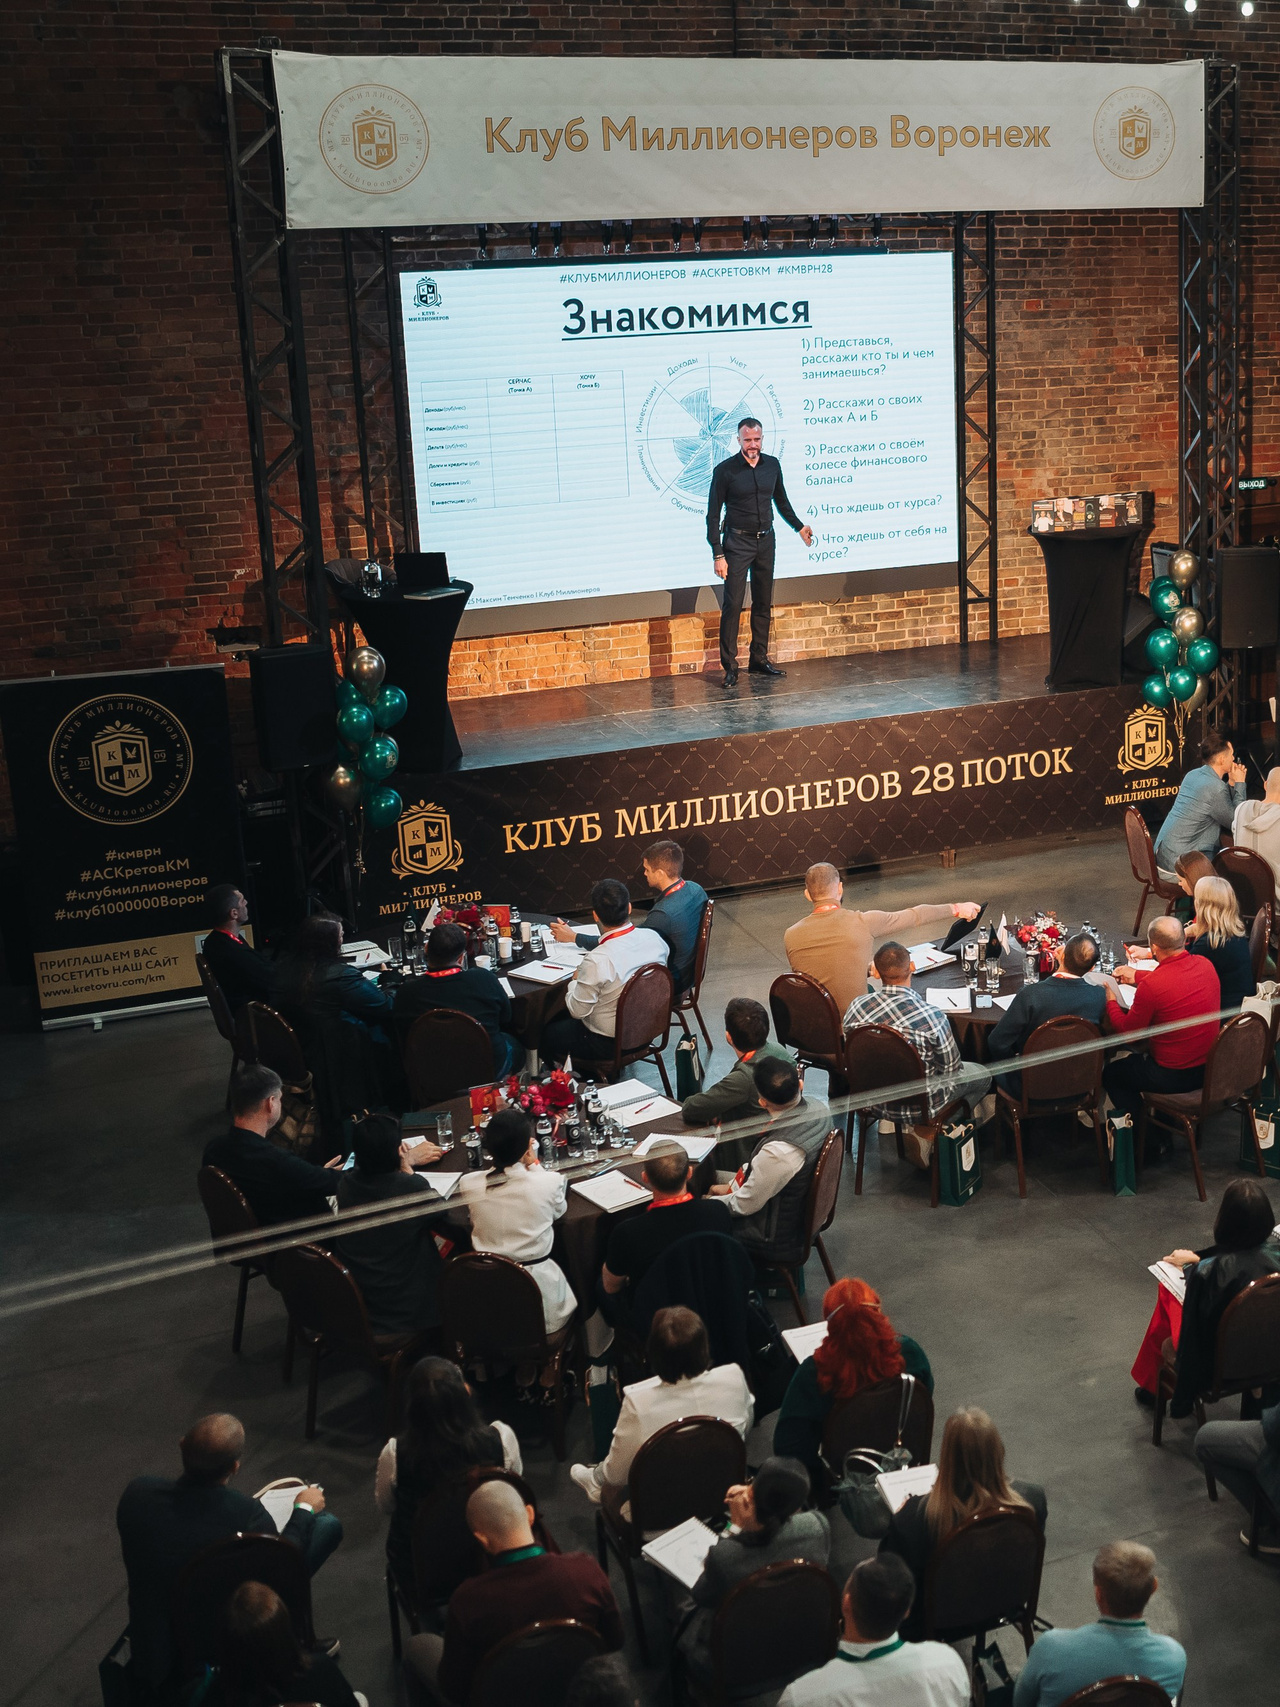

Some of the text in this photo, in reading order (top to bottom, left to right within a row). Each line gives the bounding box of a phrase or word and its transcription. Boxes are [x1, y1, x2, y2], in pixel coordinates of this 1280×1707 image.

[485, 114, 1051, 161] Клуб Миллионеров Воронеж
[559, 264, 833, 284] #КЛУБМИЛЛИОНЕРОВ #АСКРЕТОВКМ #КМВРН28
[562, 298, 810, 335] Знакомимся
[801, 336, 894, 351] 1) Представься,
[667, 356, 699, 377] Доходы
[729, 355, 748, 370] Учет
[801, 349, 934, 367] расскажи кто ты и чем
[508, 377, 531, 385] СЕЙЧАС
[802, 364, 887, 380] занимаешься?
[636, 385, 658, 433] Инвестиции
[766, 384, 784, 419] Расходы
[803, 395, 923, 413] 2) Расскажи о своих
[803, 416, 843, 425] точках
[847, 412, 856, 422] А
[871, 410, 878, 421] Б
[804, 438, 925, 458] 3) Расскажи о своём
[637, 445, 661, 492] Планирование
[805, 454, 928, 471] колесе финансового
[805, 475, 853, 486] баланса
[1239, 480, 1265, 488] ВЫХОД
[670, 497, 705, 515] Обучение
[807, 494, 942, 518] 4) Что ждешь от курса?
[822, 534, 844, 544] Что
[848, 532, 885, 543] ждешь
[888, 531, 901, 539] от
[904, 525, 931, 537] себя
[934, 526, 948, 534] на
[808, 547, 849, 563] курсе?
[539, 591, 555, 599] Клуб
[556, 587, 600, 596] Миллионеров
[61, 702, 179, 750] КЛУБ МИЛЛИОНЕРОВ
[1132, 778, 1158, 789] КЛУБ
[502, 746, 1073, 853] КЛУБ МИЛЛИОНЕРОВ 28 ПОТОК
[1105, 786, 1181, 805] МИЛЛИОНЕРО
[105, 847, 161, 862] #кмврн
[80, 858, 190, 882] #АСКретовКМ
[65, 876, 208, 901] #клубмиллионеров
[413, 883, 447, 897] КЛУБ
[54, 894, 205, 921] #клуб1000000Ворон
[39, 947, 158, 971] ПРИГЛАШАЕМ ВАС
[41, 956, 179, 984] ПОСЕТИТЬ НАШ САЙТ
[43, 974, 166, 998] www.kretovru.com/km
